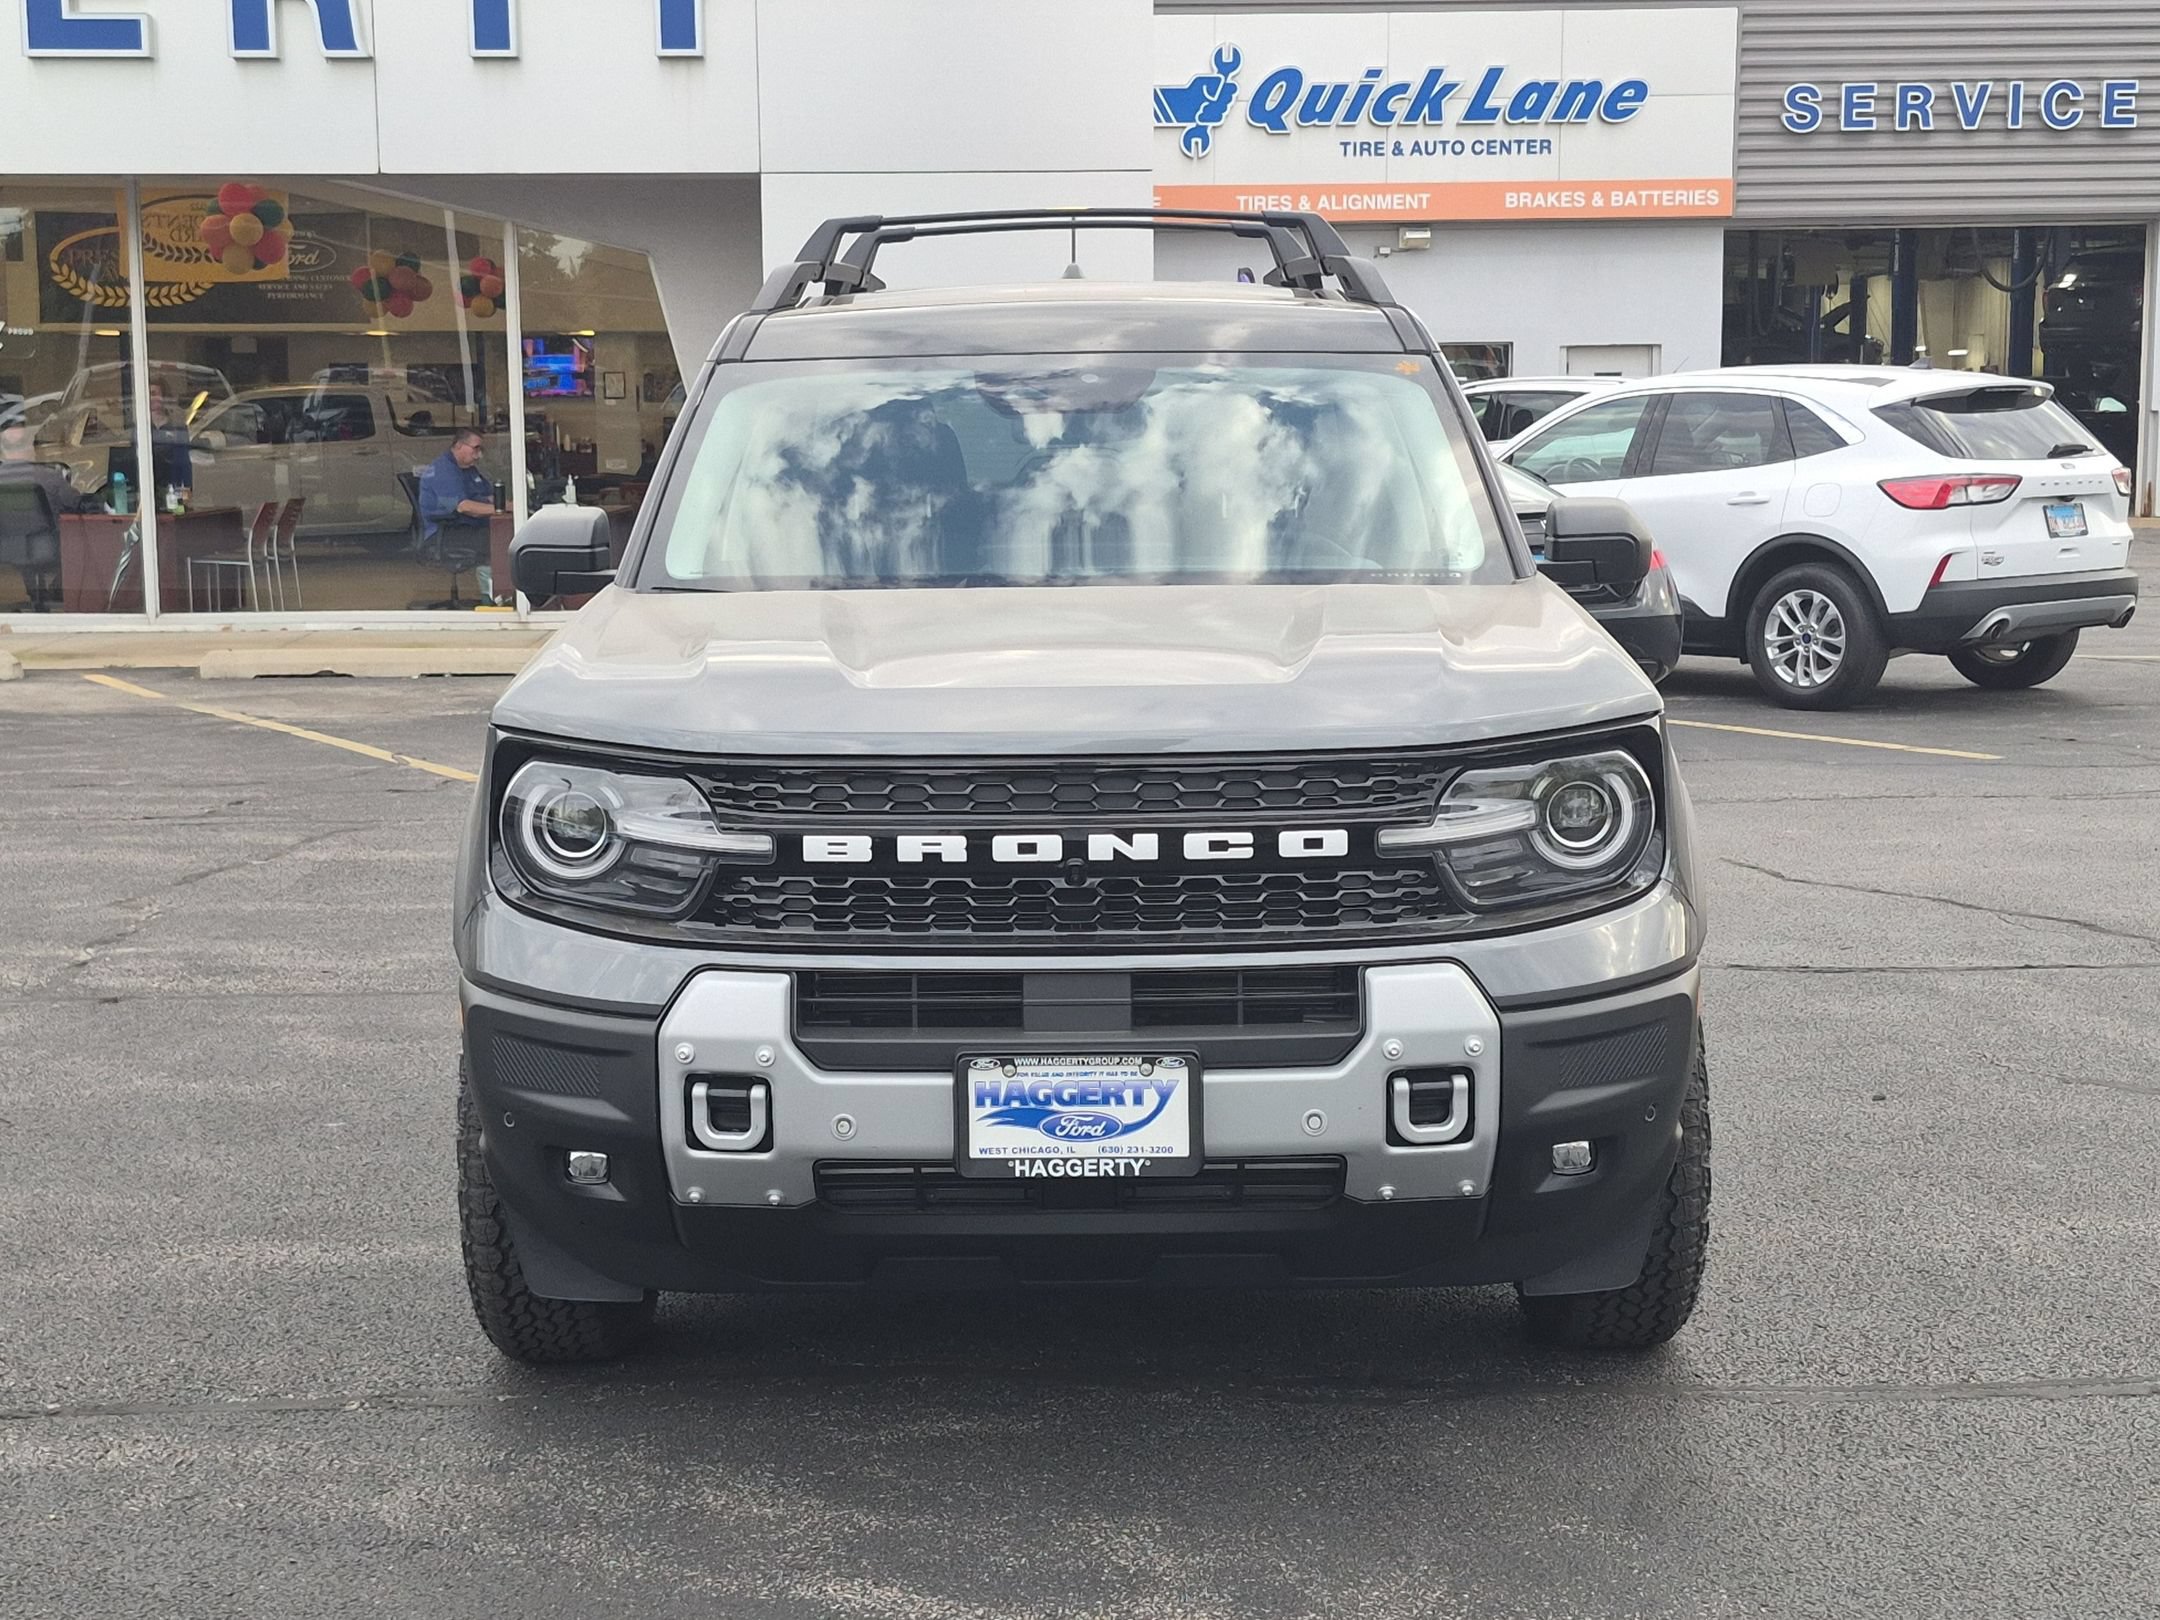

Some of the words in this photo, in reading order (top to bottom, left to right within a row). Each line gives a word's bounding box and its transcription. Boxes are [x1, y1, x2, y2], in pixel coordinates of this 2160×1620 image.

[1248, 65, 1457, 134] Quick
[1460, 64, 1649, 125] Lane
[1781, 78, 2140, 134] SERVICE
[1340, 141, 1385, 157] TIRE
[1391, 140, 1404, 156] &
[1410, 140, 1465, 156] AUTO
[1471, 139, 1552, 156] CENTER
[1236, 195, 1293, 211] TIRES
[1299, 195, 1311, 210] &
[1317, 193, 1431, 210] ALIGNMENT
[1505, 191, 1586, 208] BRAKES
[1591, 191, 1605, 207] &
[1611, 190, 1720, 207] BATTERIES
[802, 829, 1350, 863] BRONCO
[1014, 1057, 1142, 1067] WWW.HAGGERTYGROUP.COM
[975, 1080, 1179, 1108] HAGGERTY
[1055, 1115, 1106, 1137] Ford
[979, 1146, 1007, 1155] WEST
[1011, 1146, 1063, 1156] CHICAGO,
[1066, 1146, 1076, 1154] IL
[1098, 1146, 1124, 1155] (630)
[1127, 1146, 1174, 1154] 231-3200
[1014, 1159, 1146, 1177] HAGGERTY
